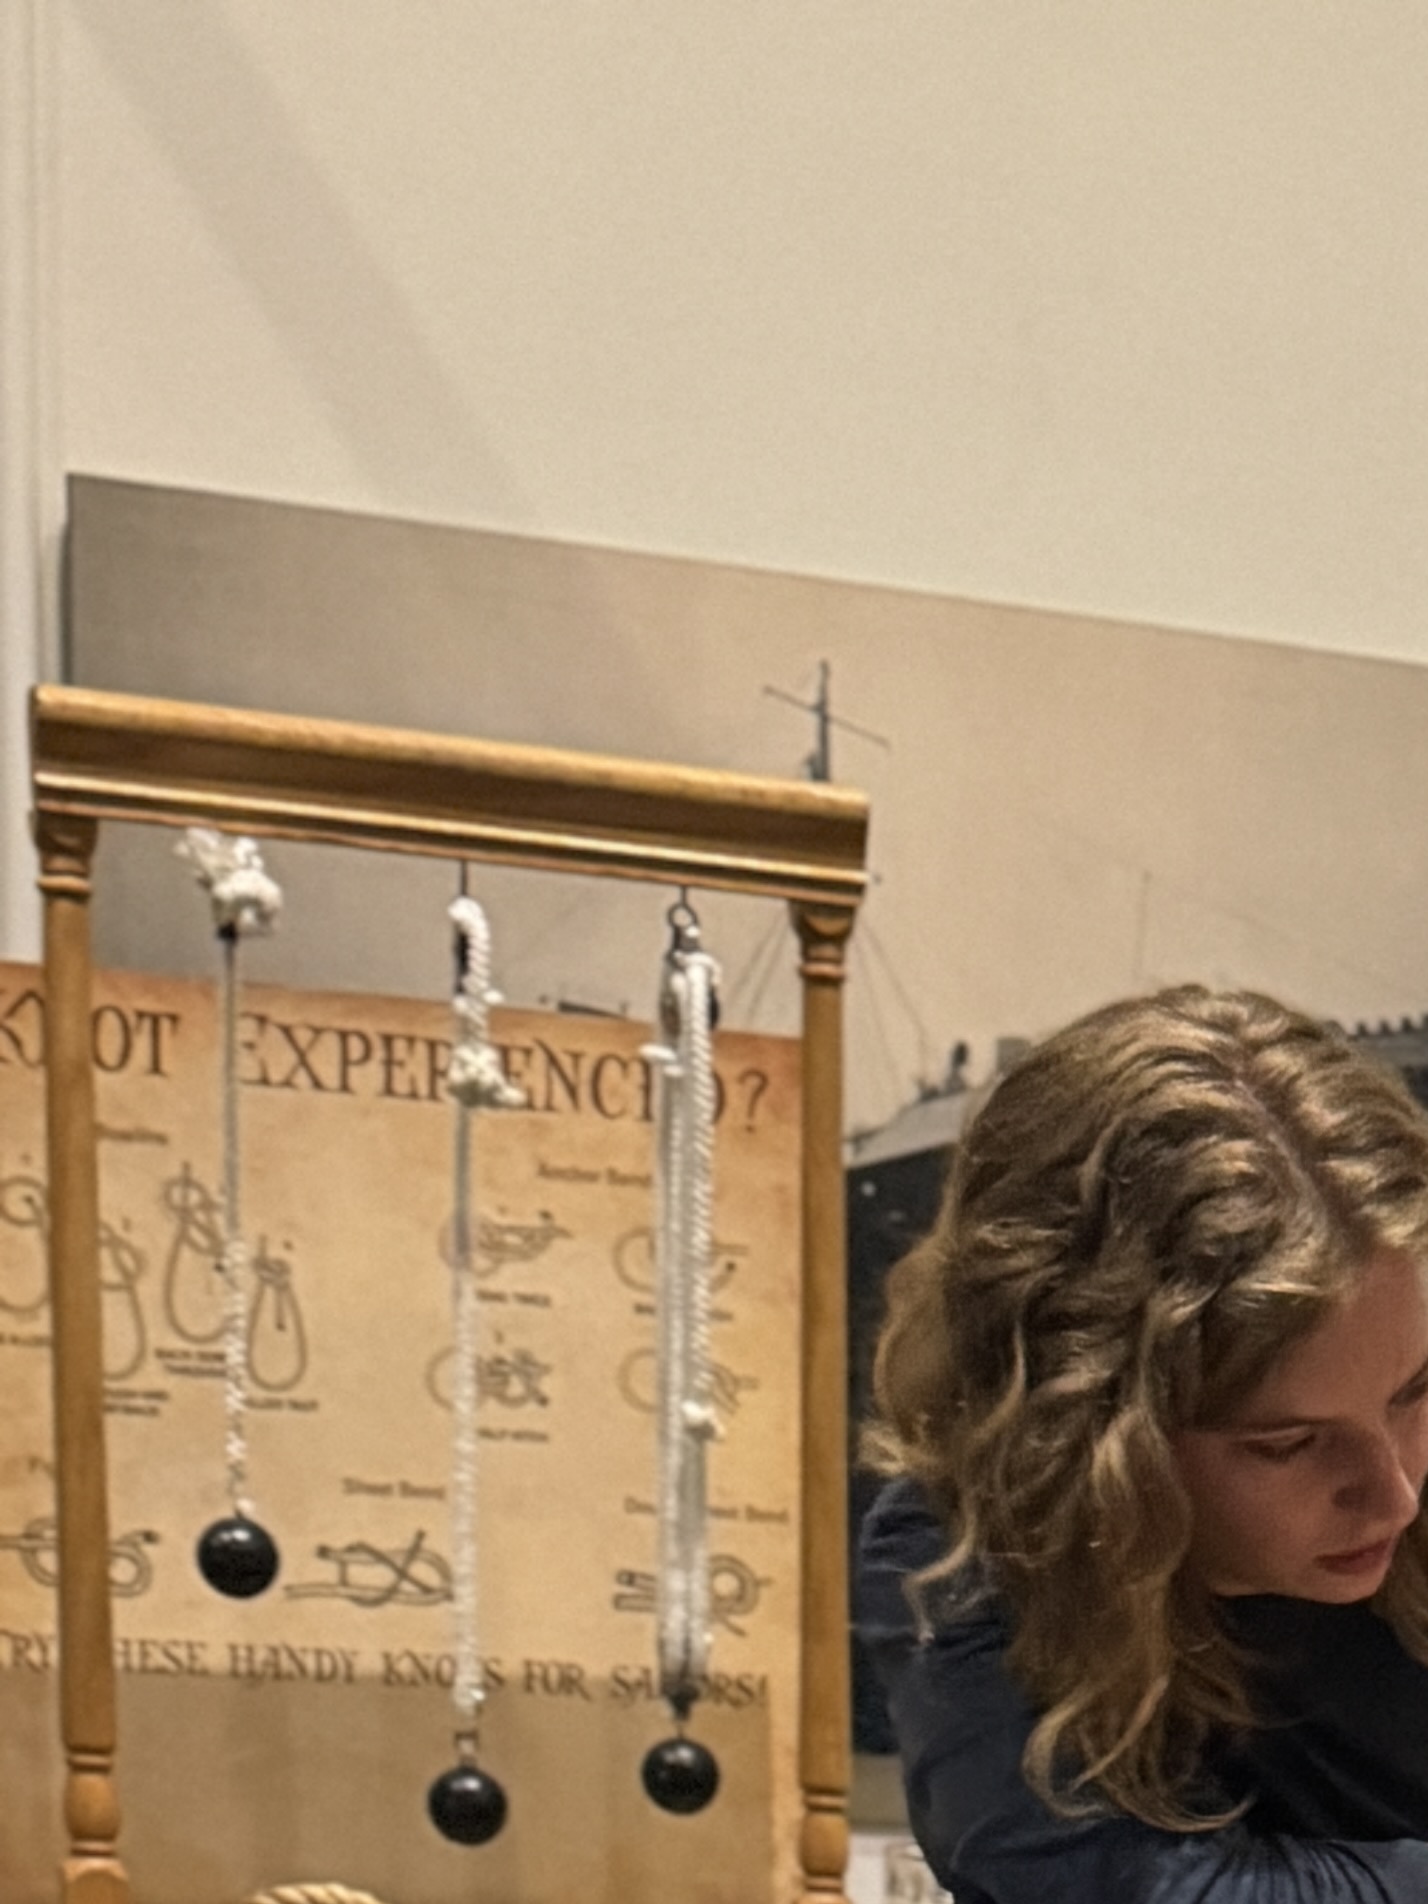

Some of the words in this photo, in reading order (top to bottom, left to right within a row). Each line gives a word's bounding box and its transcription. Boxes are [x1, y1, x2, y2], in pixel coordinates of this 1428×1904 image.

[113, 1637, 210, 1678] HESE
[228, 1642, 357, 1684] HANDY
[381, 1650, 504, 1689] KNOS
[523, 1658, 590, 1701] FOR
